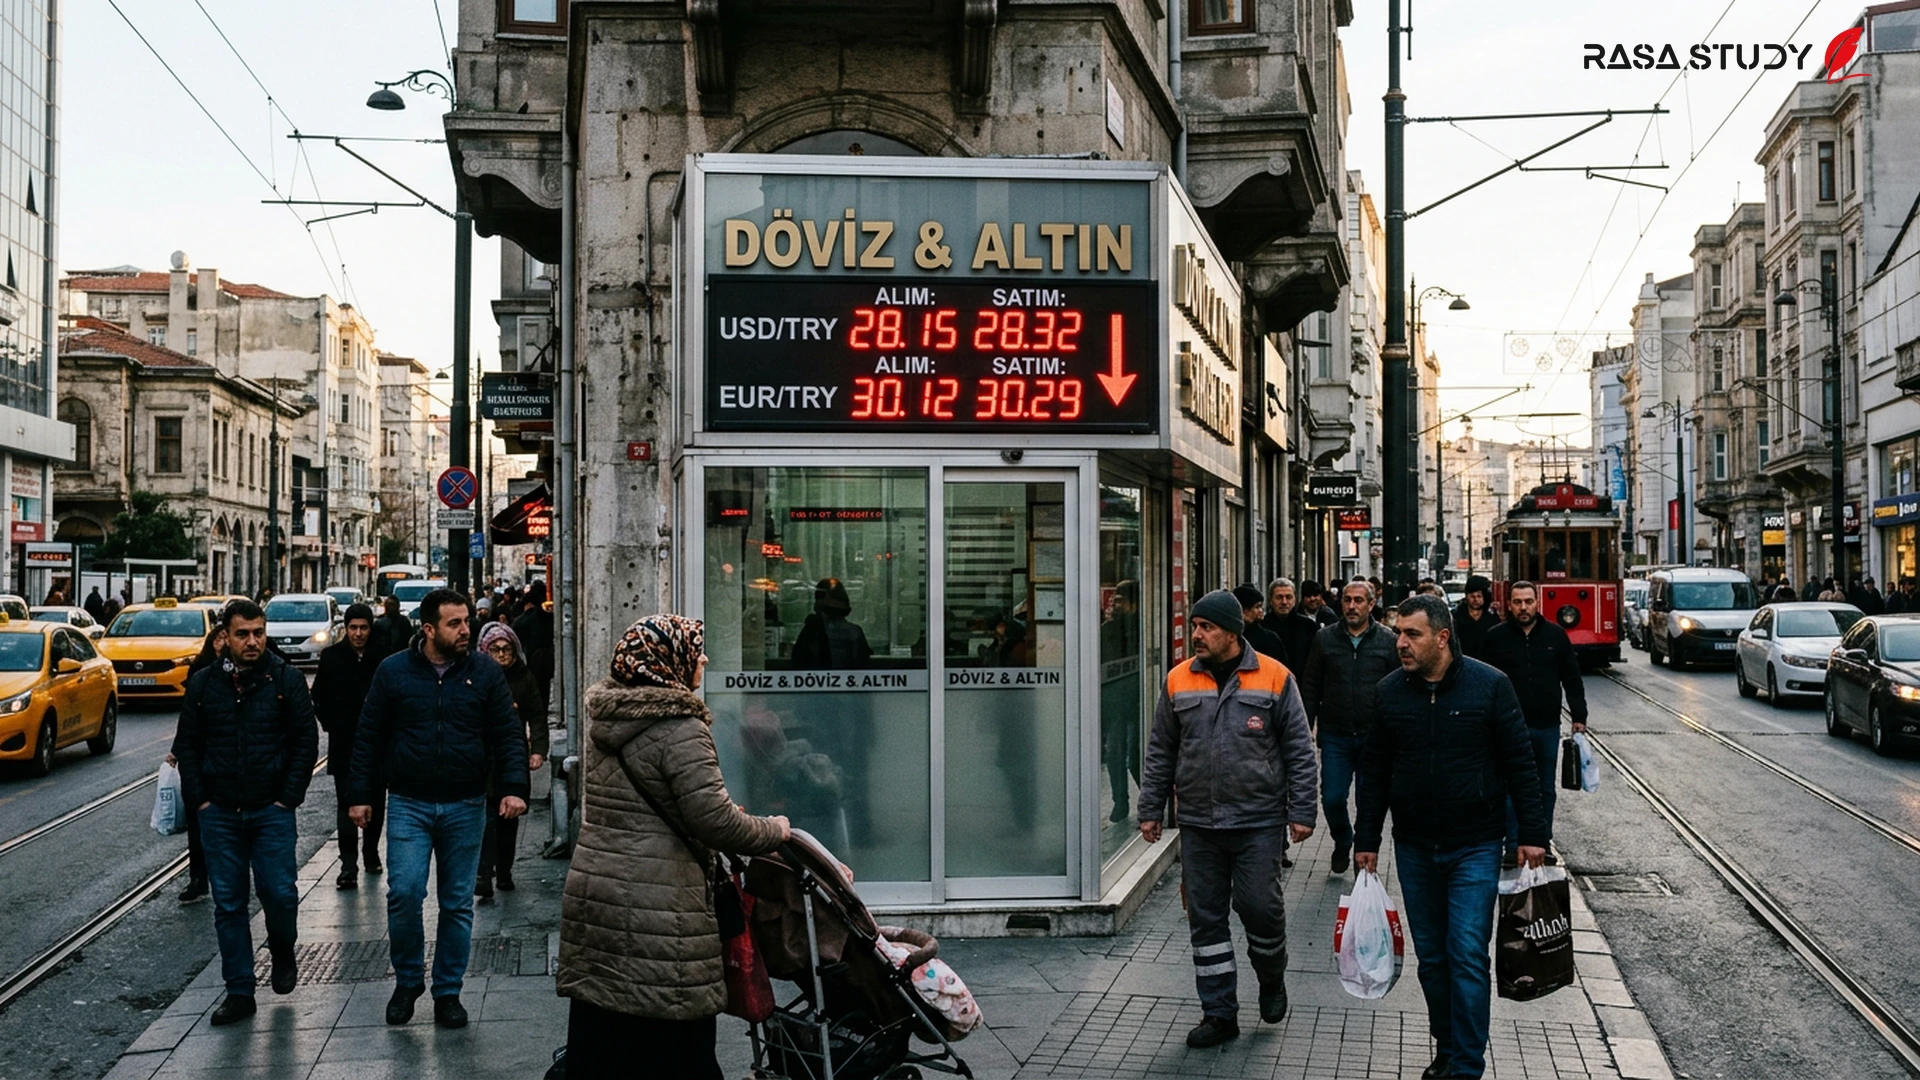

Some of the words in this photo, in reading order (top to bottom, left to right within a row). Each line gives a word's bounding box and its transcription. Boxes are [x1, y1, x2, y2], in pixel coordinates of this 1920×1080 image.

[725, 208, 895, 268] DÖVİZ
[914, 220, 952, 269] &
[971, 222, 1132, 271] ALTIN
[875, 287, 936, 306] ALIM:
[992, 288, 1066, 307] SATIM:
[719, 317, 838, 340] USD/TRY
[850, 309, 957, 348] 28.15
[974, 311, 1082, 350] 28.32
[874, 356, 936, 374] ALIM:
[992, 357, 1066, 375] SATIM:
[719, 385, 838, 408] EUR/TRY
[851, 378, 958, 417] 30.12
[976, 379, 1082, 418] 30.29
[861, 674, 908, 687] ALTIN
[1000, 672, 1011, 685] &
[1015, 672, 1060, 684] ALTIN
